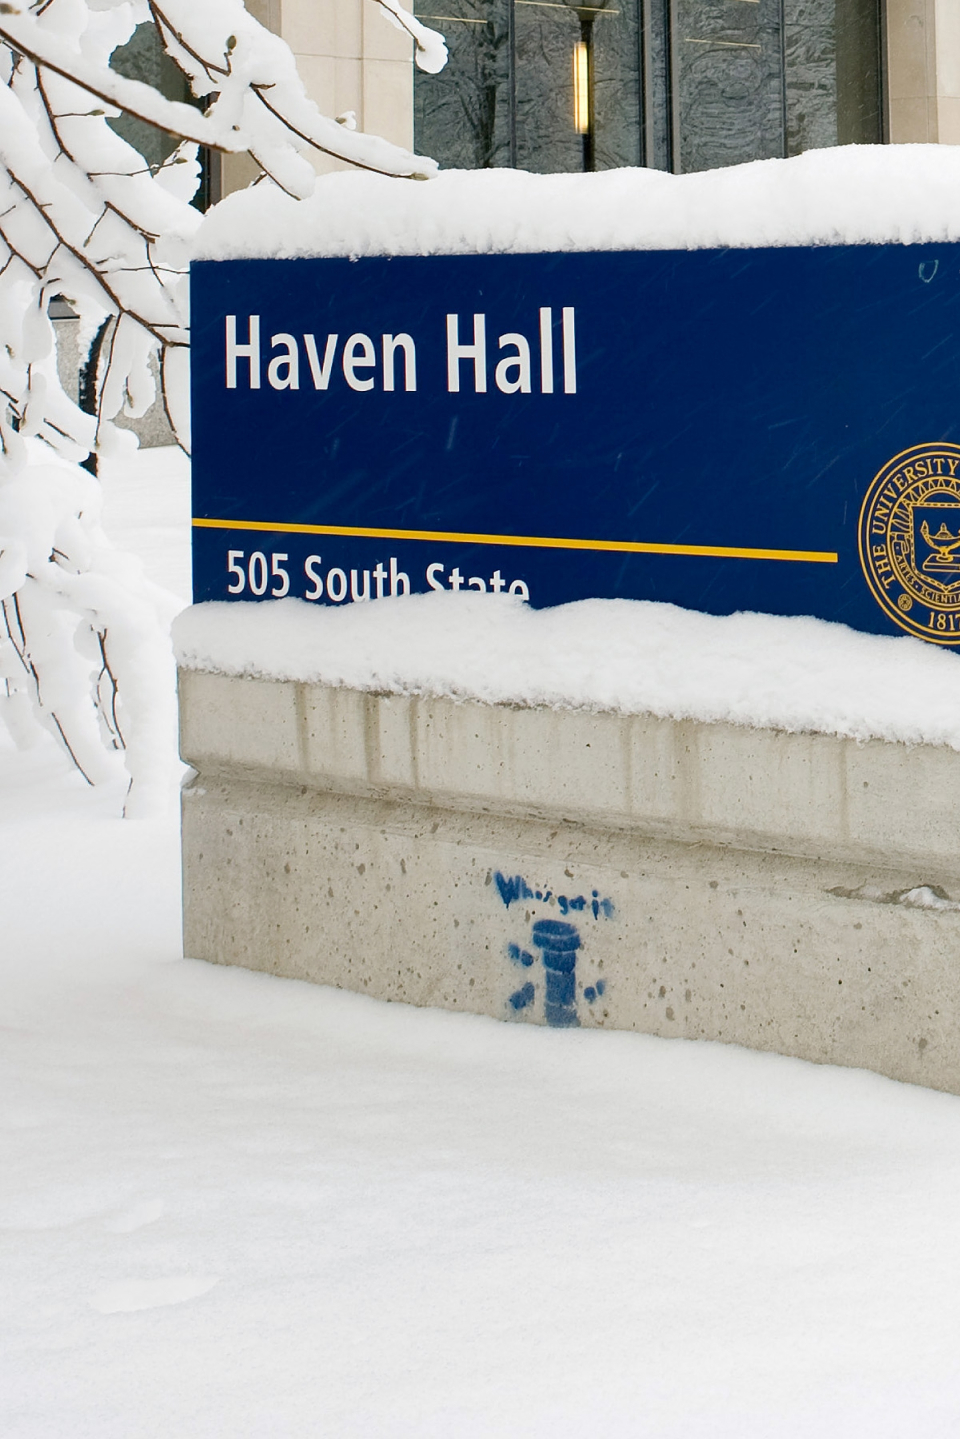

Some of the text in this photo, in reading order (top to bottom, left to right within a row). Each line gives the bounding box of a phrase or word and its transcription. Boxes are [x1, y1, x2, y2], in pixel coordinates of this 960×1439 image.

[225, 306, 577, 394] Haven Hall
[872, 458, 960, 535] UNIVERSITY
[226, 549, 291, 598] 505
[304, 554, 411, 603] South
[872, 544, 896, 589] THE
[895, 555, 915, 585] ARTES
